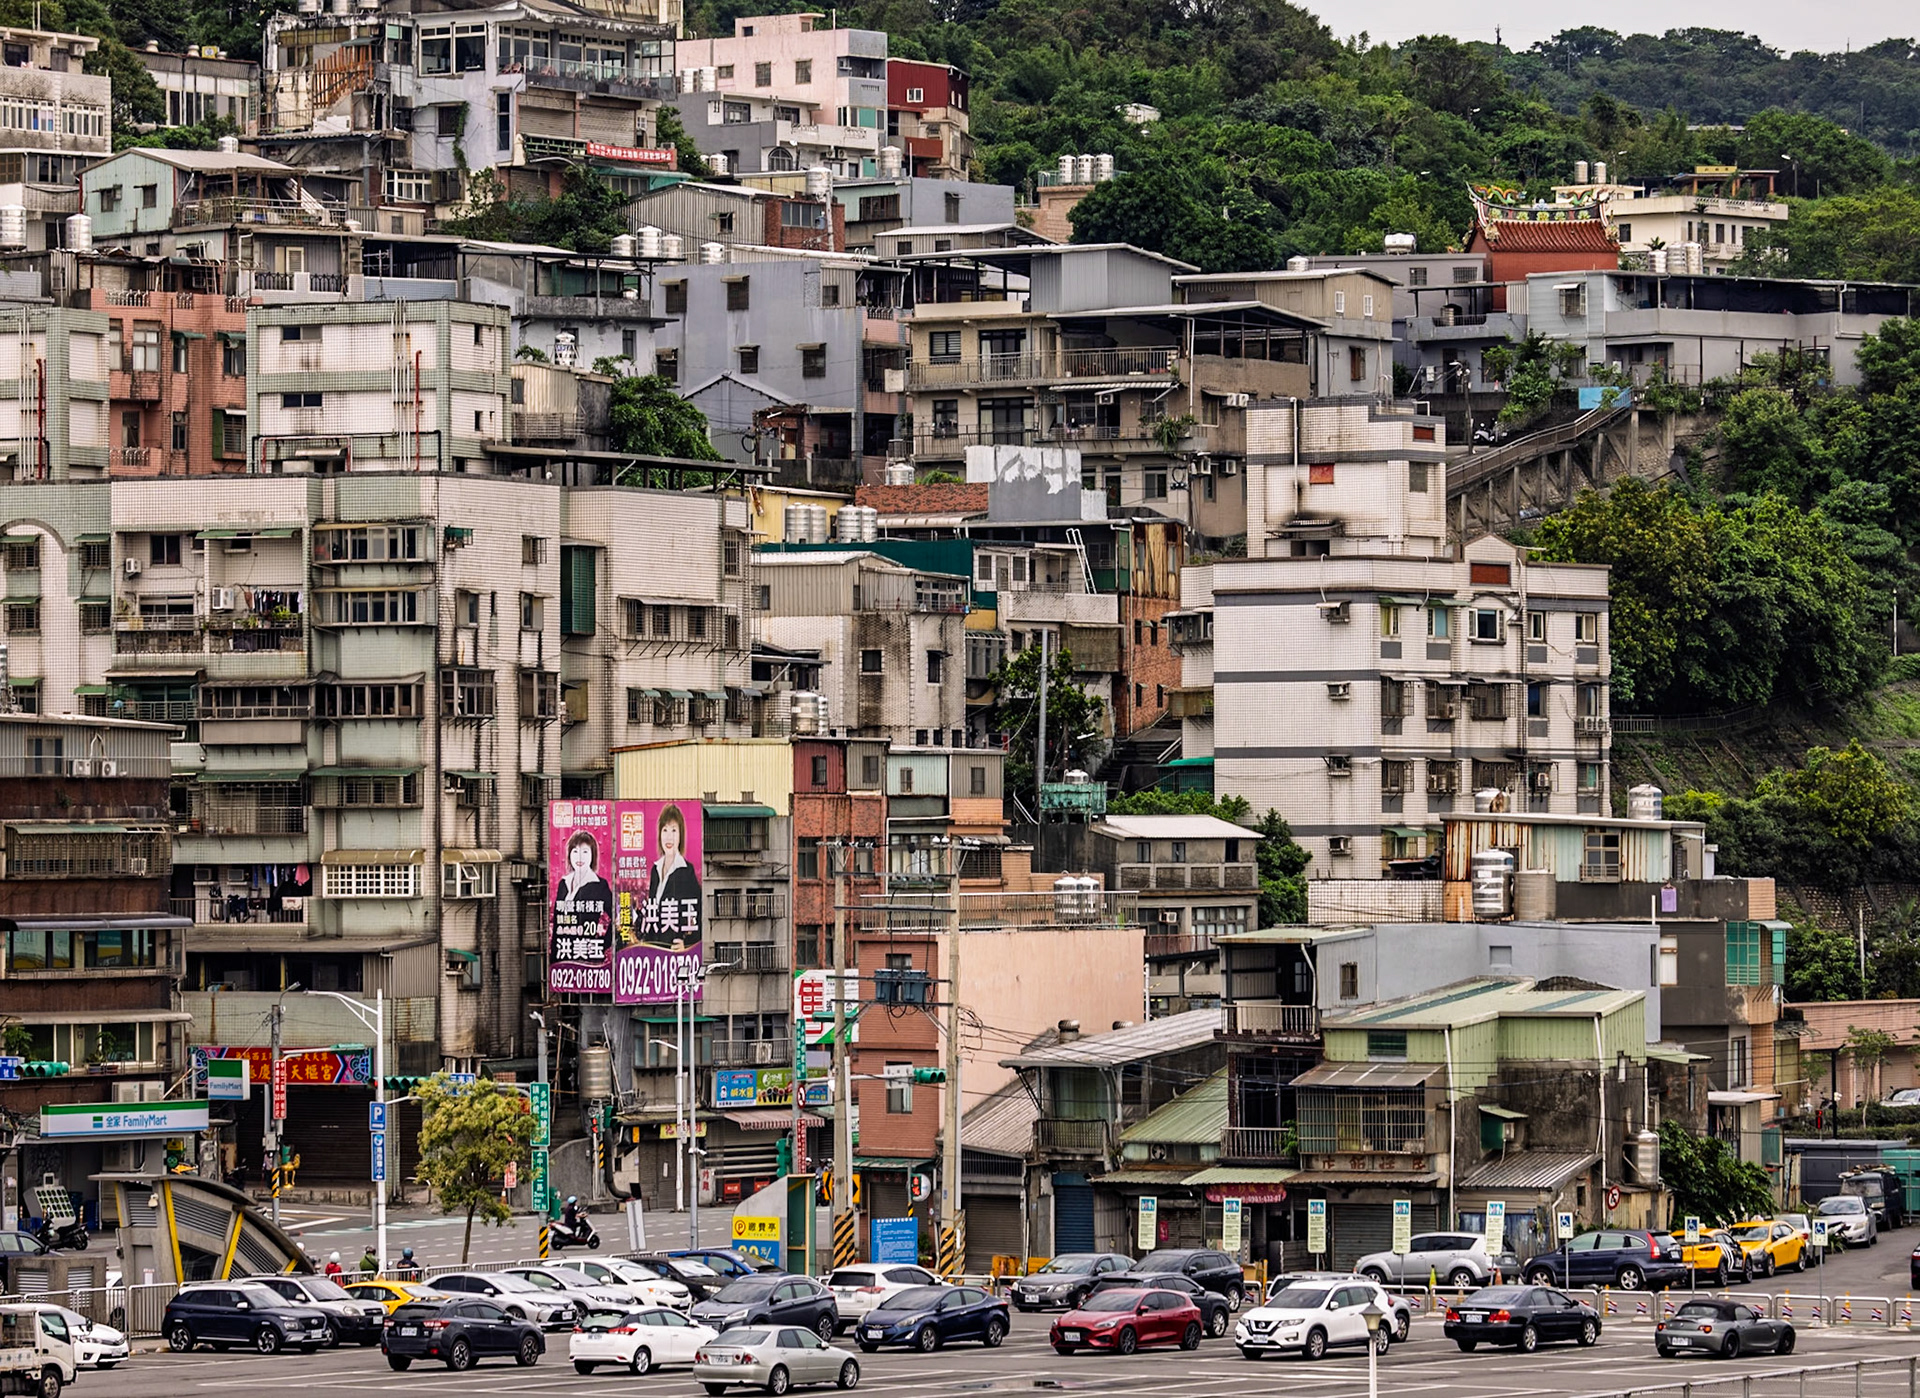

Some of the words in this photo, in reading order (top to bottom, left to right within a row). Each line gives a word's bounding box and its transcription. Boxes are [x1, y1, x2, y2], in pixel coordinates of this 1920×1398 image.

[575, 804, 607, 815] 信義君悅
[573, 816, 608, 826] 特許加盟店
[618, 857, 647, 868] 信義君悅
[618, 869, 647, 879] 特許加盟店
[619, 892, 632, 942] 請指名
[640, 898, 699, 934] 洪美玉
[556, 938, 605, 960] 洪美玉
[798, 979, 824, 1034] 售
[210, 1081, 242, 1092] FamilyMart
[374, 1106, 383, 1121] P
[105, 1116, 121, 1128] 全家
[123, 1114, 168, 1129] FamilyMart
[748, 1222, 776, 1232] 繳費亭
